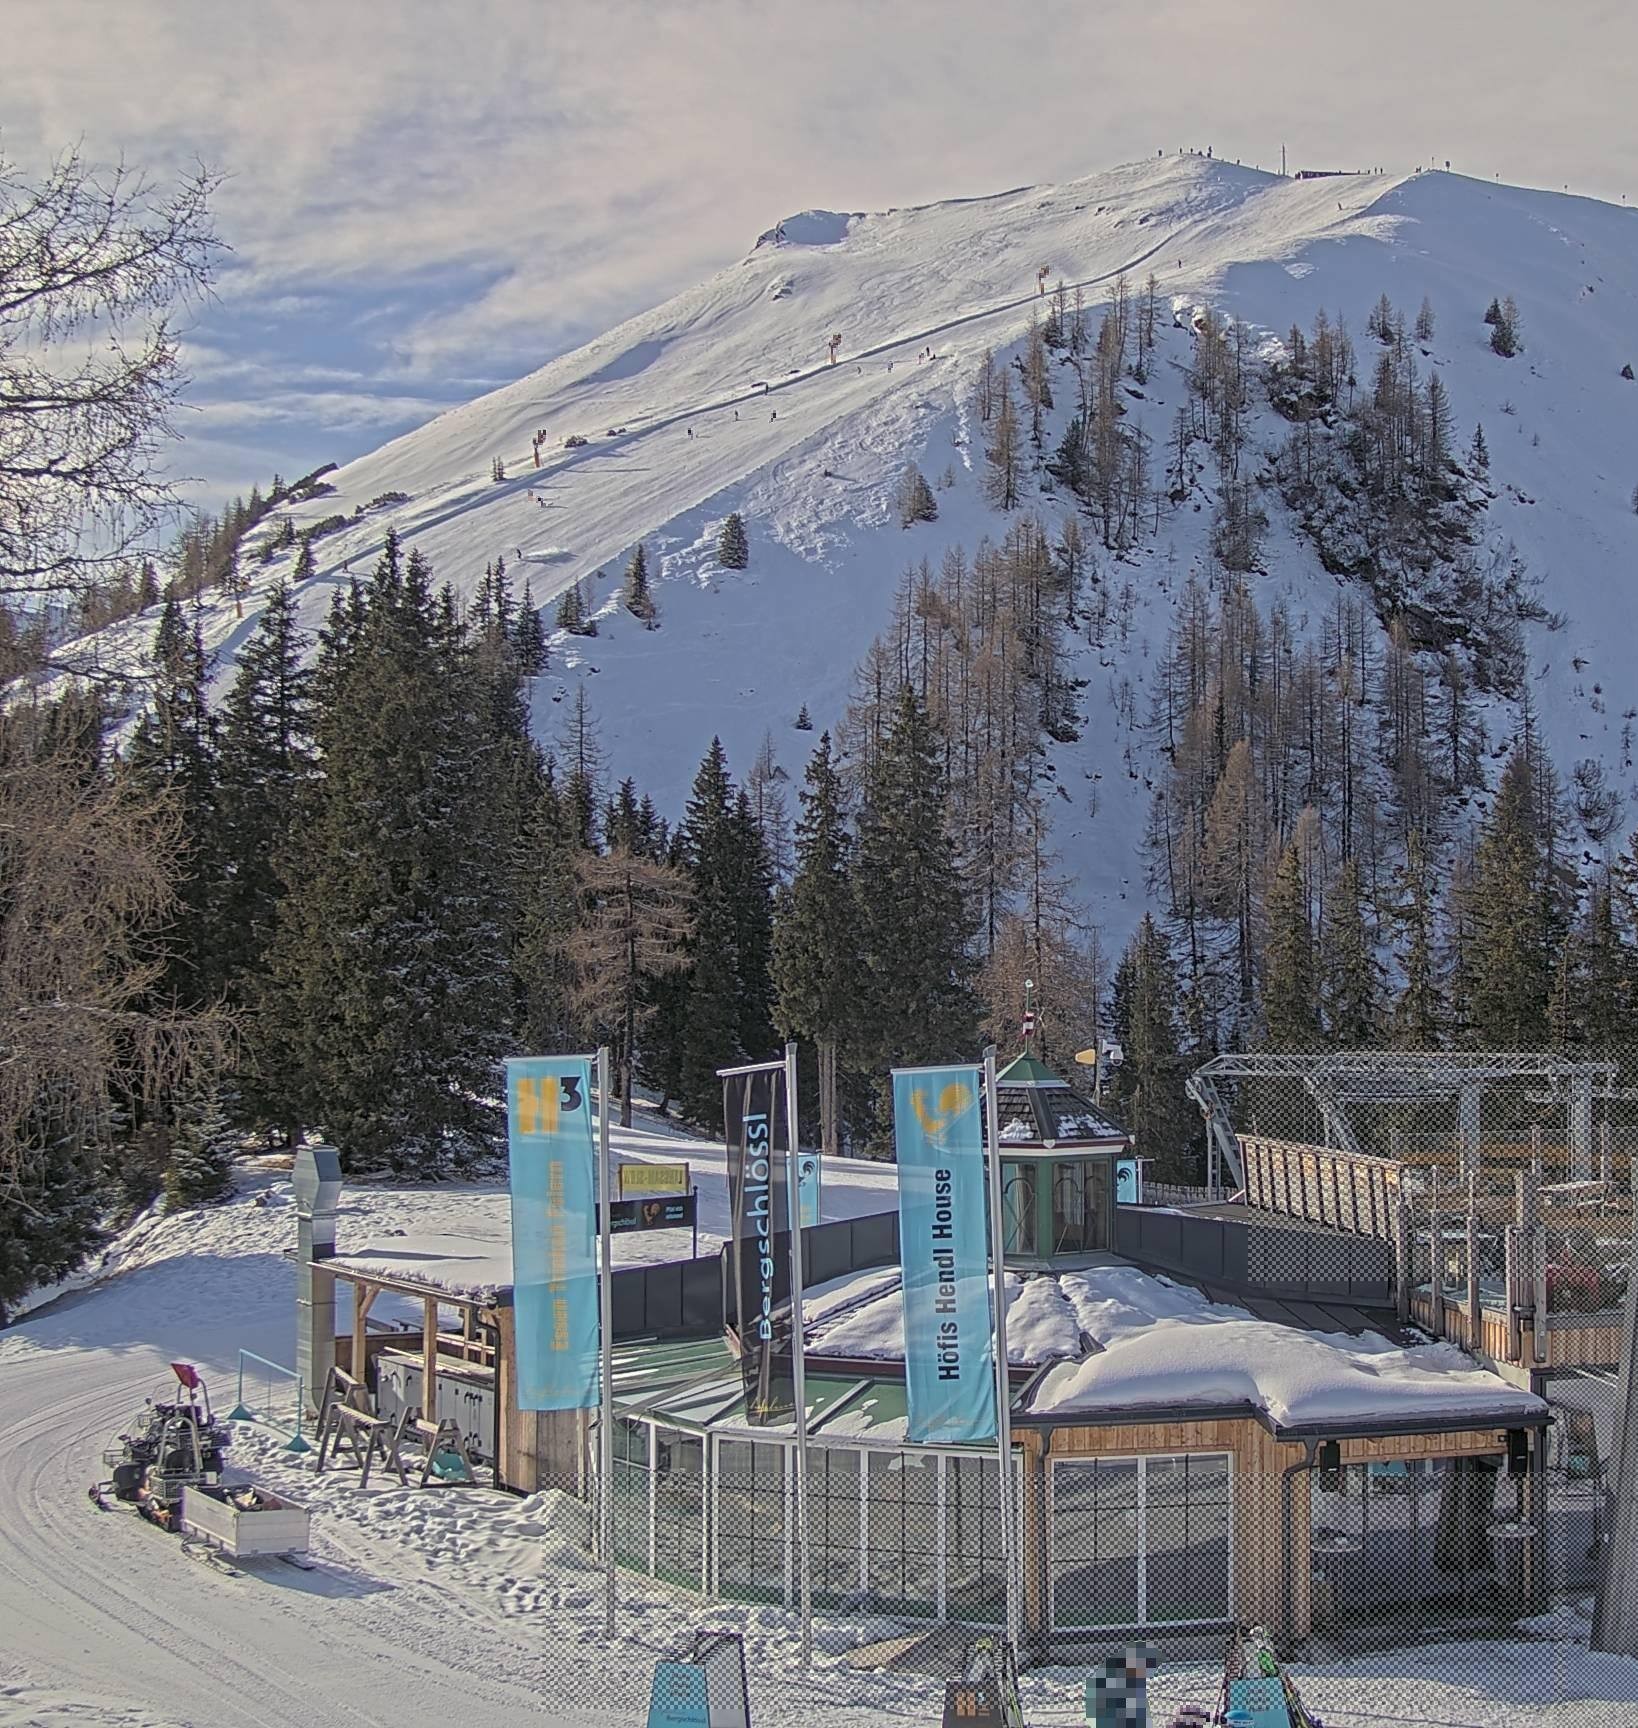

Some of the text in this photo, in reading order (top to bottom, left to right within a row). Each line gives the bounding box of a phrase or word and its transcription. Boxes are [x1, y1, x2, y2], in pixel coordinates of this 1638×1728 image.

[743, 1113, 774, 1340] Bergschlössl
[932, 1169, 960, 1381] Höfis Hendl House
